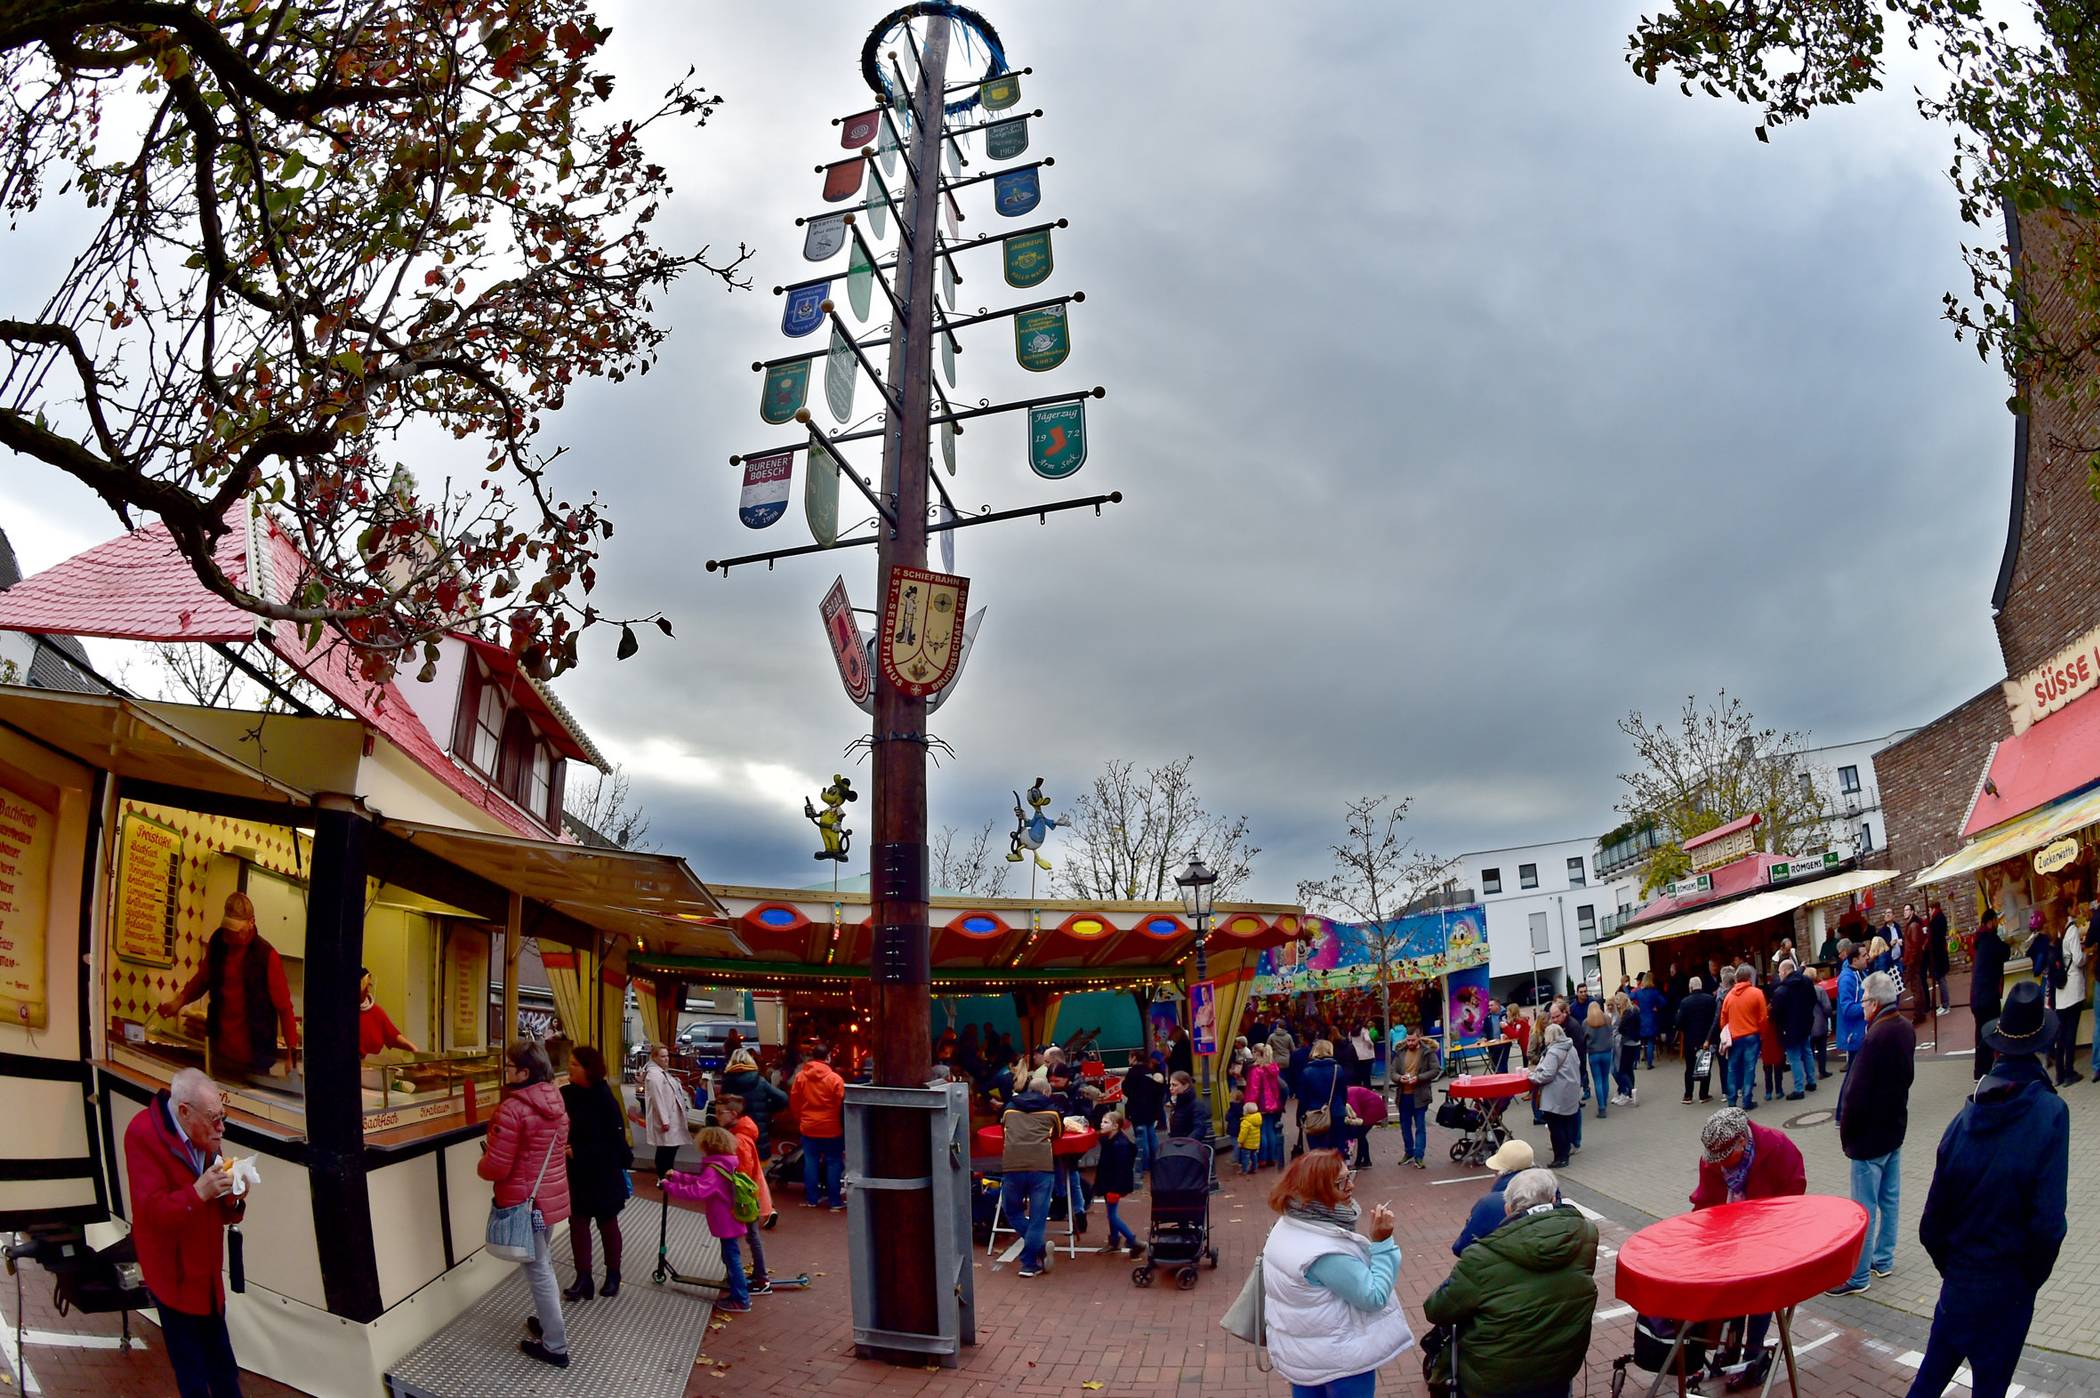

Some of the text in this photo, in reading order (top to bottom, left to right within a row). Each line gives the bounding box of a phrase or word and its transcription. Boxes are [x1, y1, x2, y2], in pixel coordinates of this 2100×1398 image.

[1034, 409, 1078, 423] Jägerzug
[1035, 429, 1080, 443] 19 72
[750, 467, 785, 480] BOESCH
[903, 570, 960, 586] SCHIEFBAHN
[931, 618, 964, 691] BRUDERSCHAFT
[2034, 654, 2090, 708] SÜSSE
[2038, 845, 2074, 869] Zuckerwatte
[1790, 860, 1823, 874] RÖMGENS
